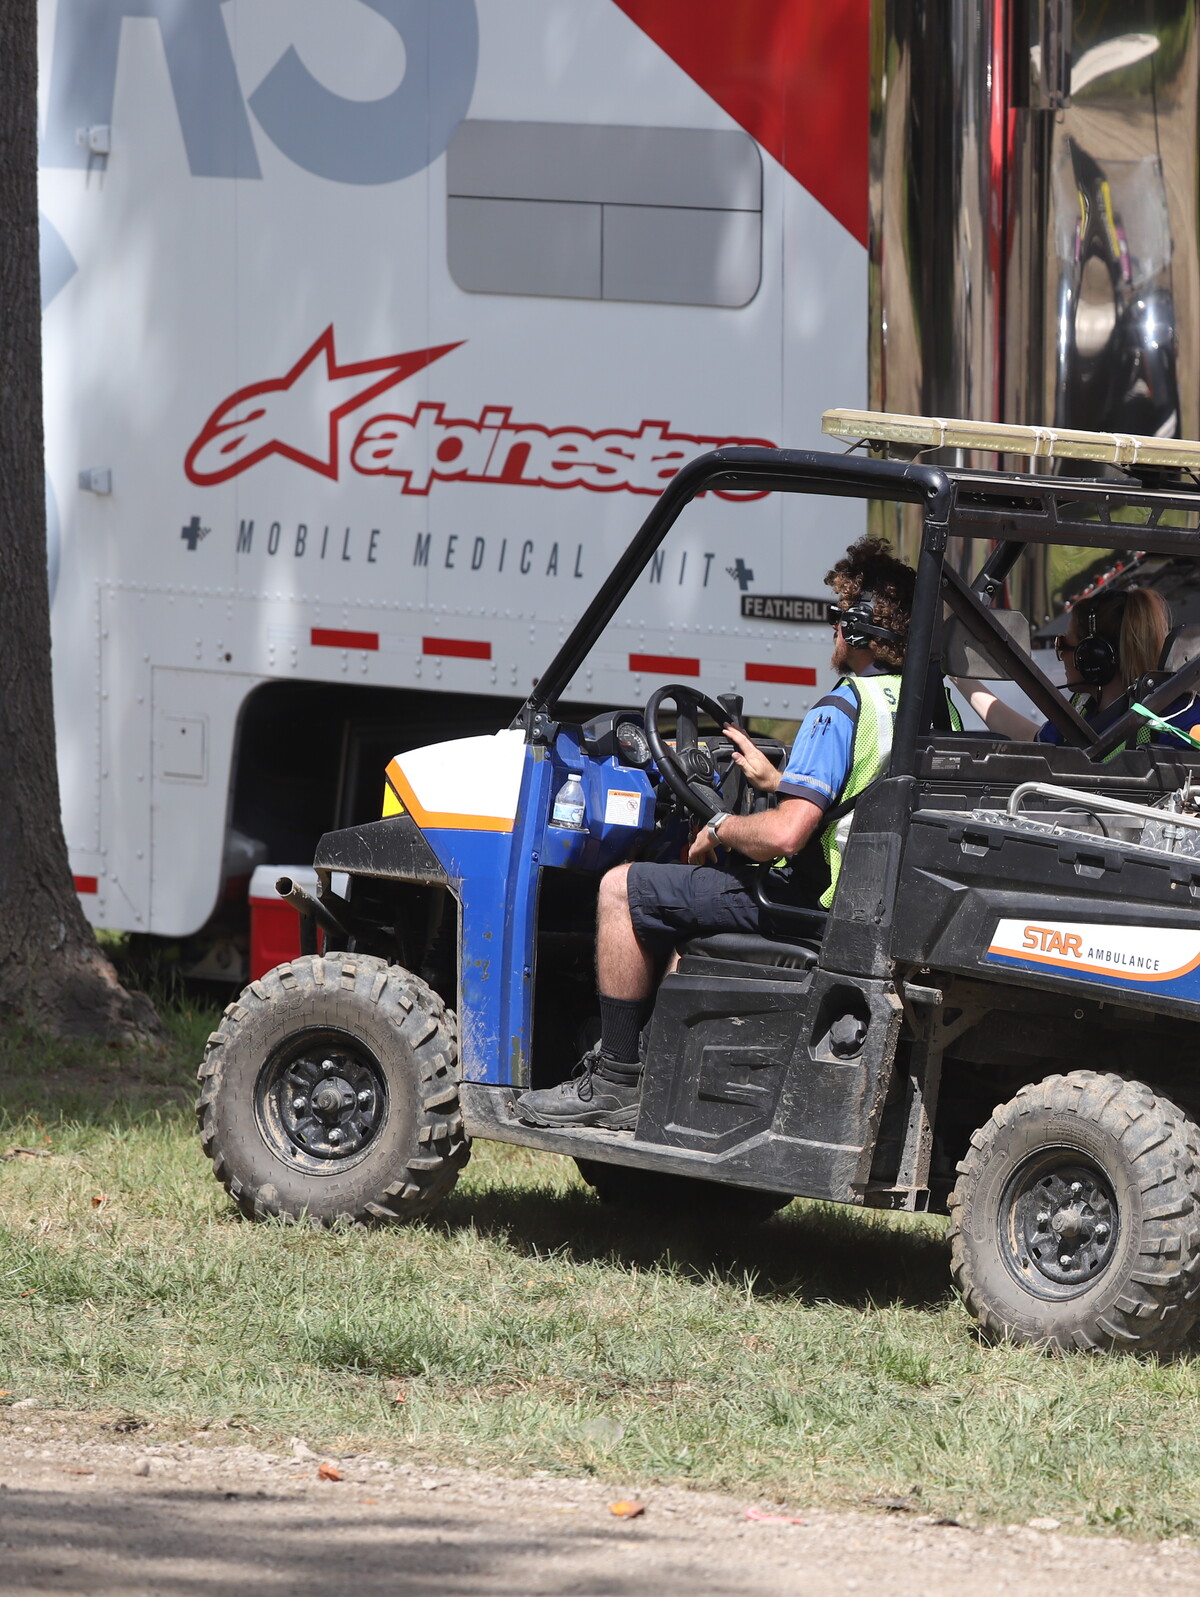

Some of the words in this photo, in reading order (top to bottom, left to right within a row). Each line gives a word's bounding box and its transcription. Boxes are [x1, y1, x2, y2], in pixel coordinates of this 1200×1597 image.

[351, 402, 779, 503] alpinesta
[236, 519, 381, 563] MOBILE
[413, 532, 584, 579] MEDICAL
[650, 550, 716, 588] NIT
[745, 596, 829, 622] FEATHERLI
[1022, 925, 1083, 958] STAR
[1087, 947, 1160, 971] AMBULANCE
